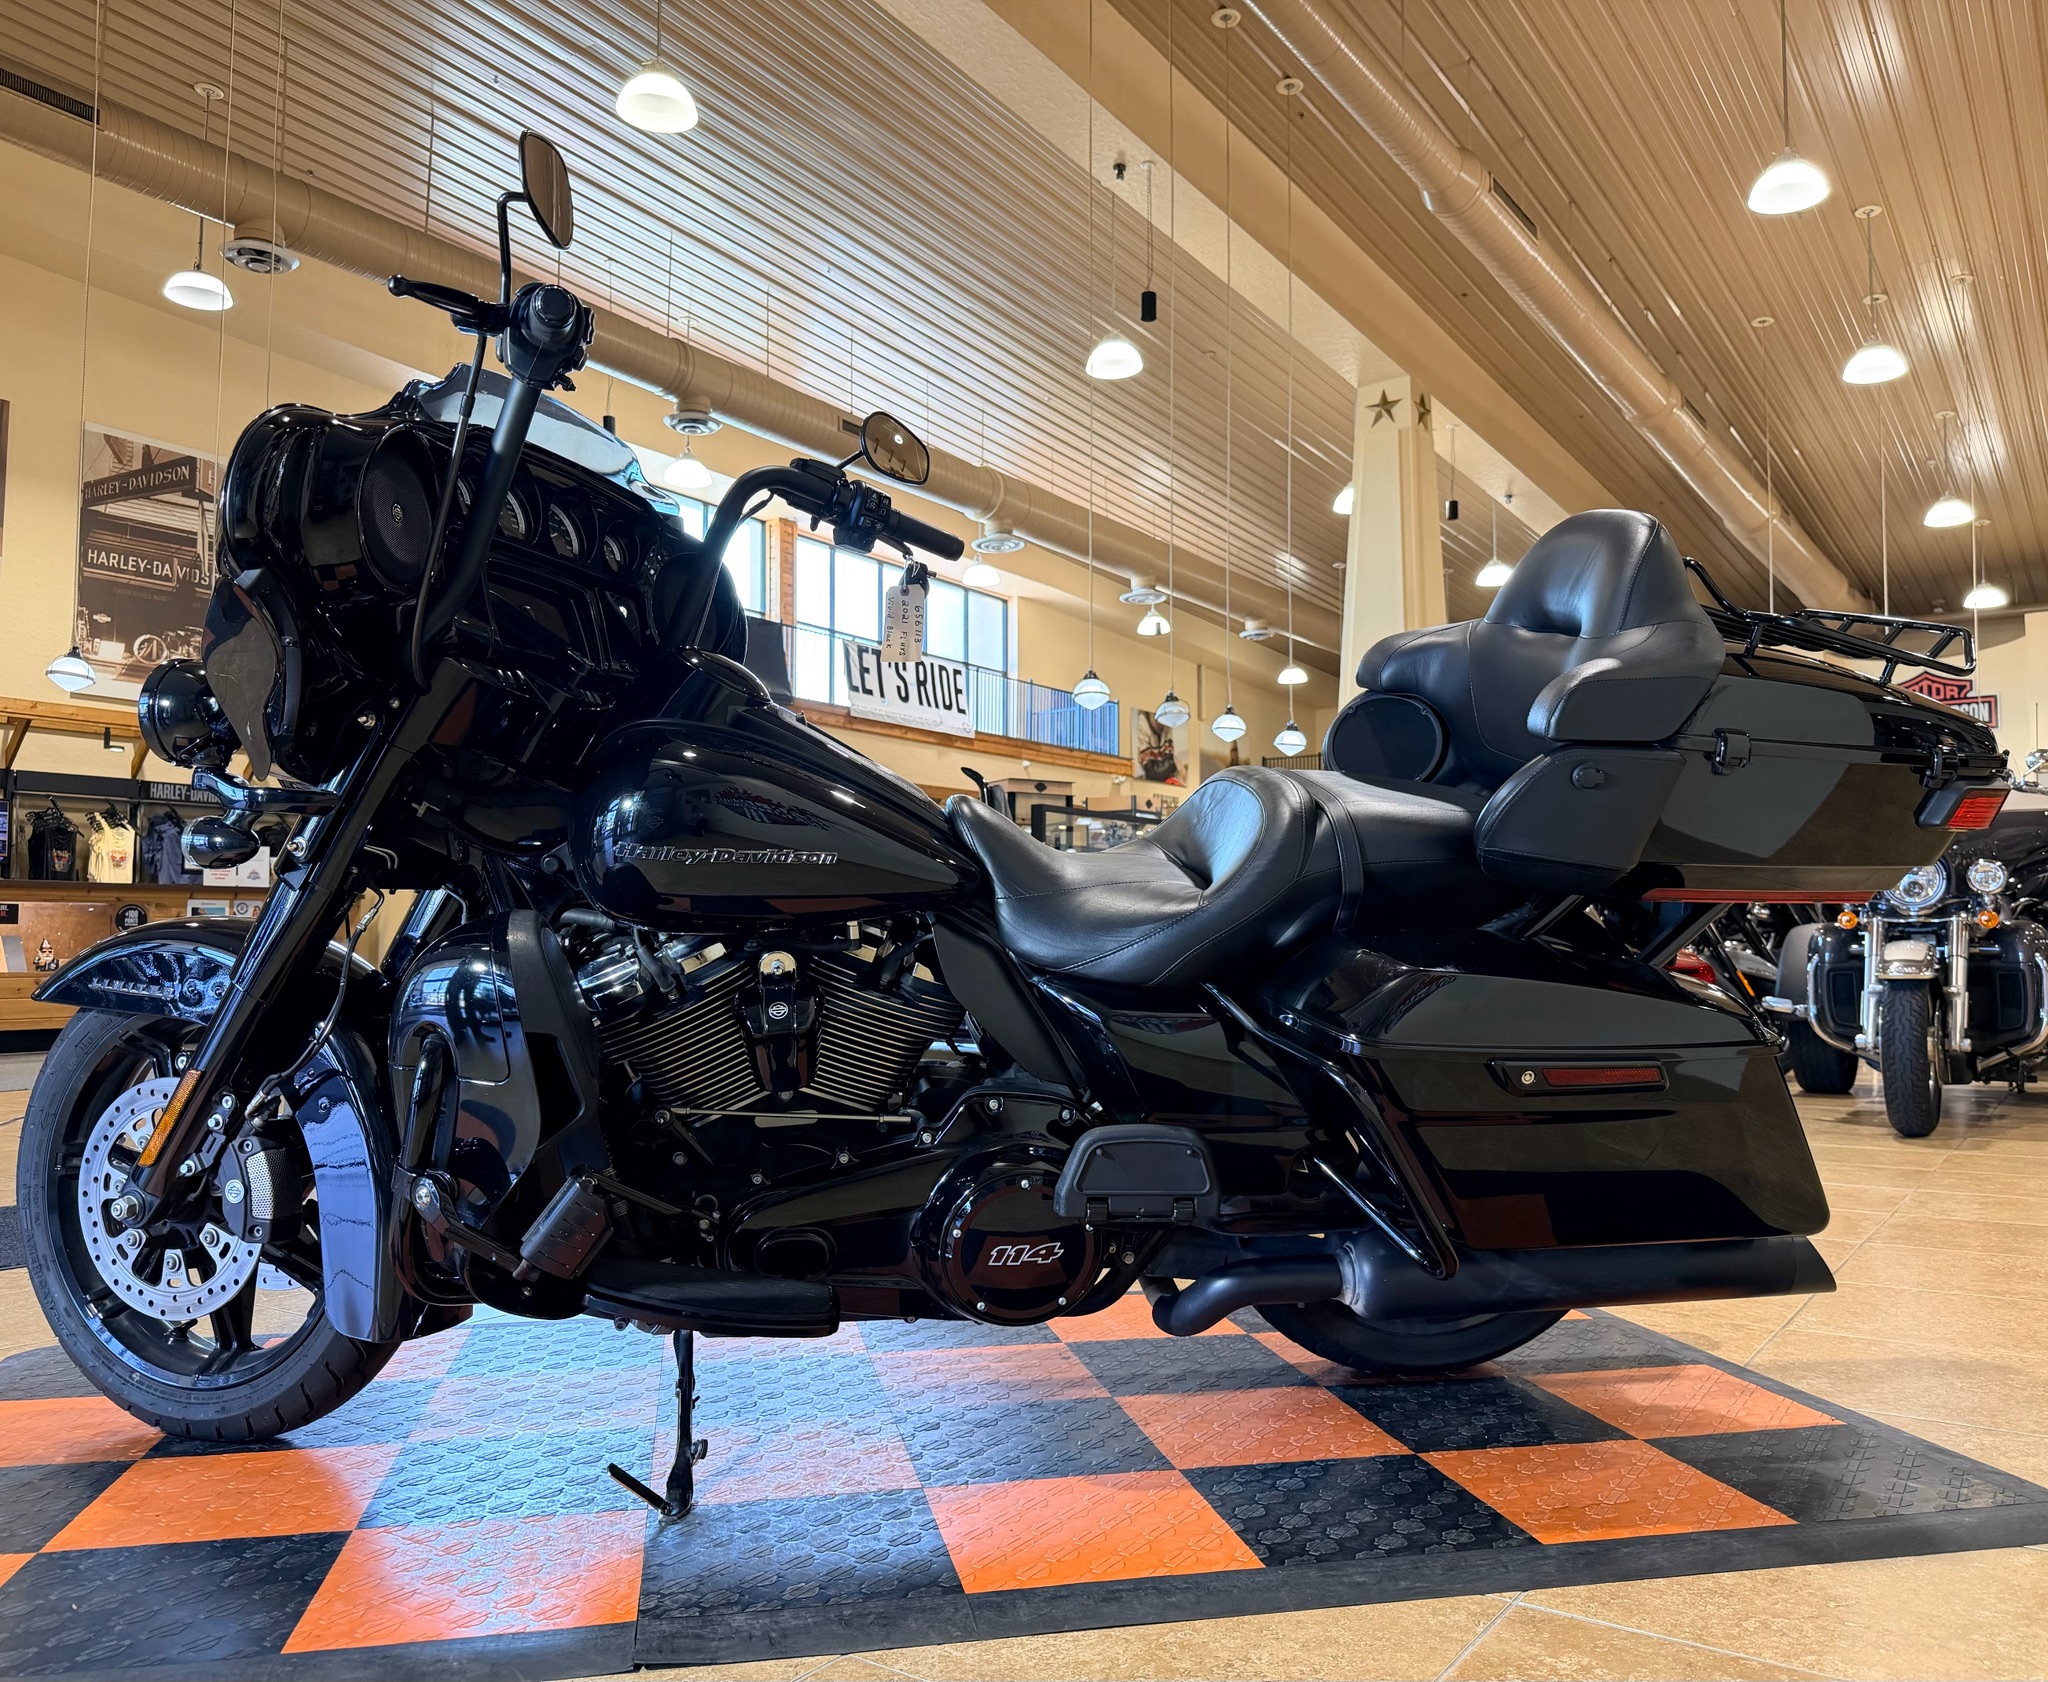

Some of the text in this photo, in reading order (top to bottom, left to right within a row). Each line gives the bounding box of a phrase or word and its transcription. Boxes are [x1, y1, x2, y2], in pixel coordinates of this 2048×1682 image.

[85, 465, 190, 499] HARLEY-DAVIDSON
[87, 549, 209, 585] HARLEY-DAVIDS
[901, 600, 909, 624] 2021
[915, 660, 967, 715] RIDE
[150, 783, 222, 803] HARLEY-DAVID
[613, 841, 838, 865] Harley-Davidson
[988, 1242, 1064, 1266] 114
